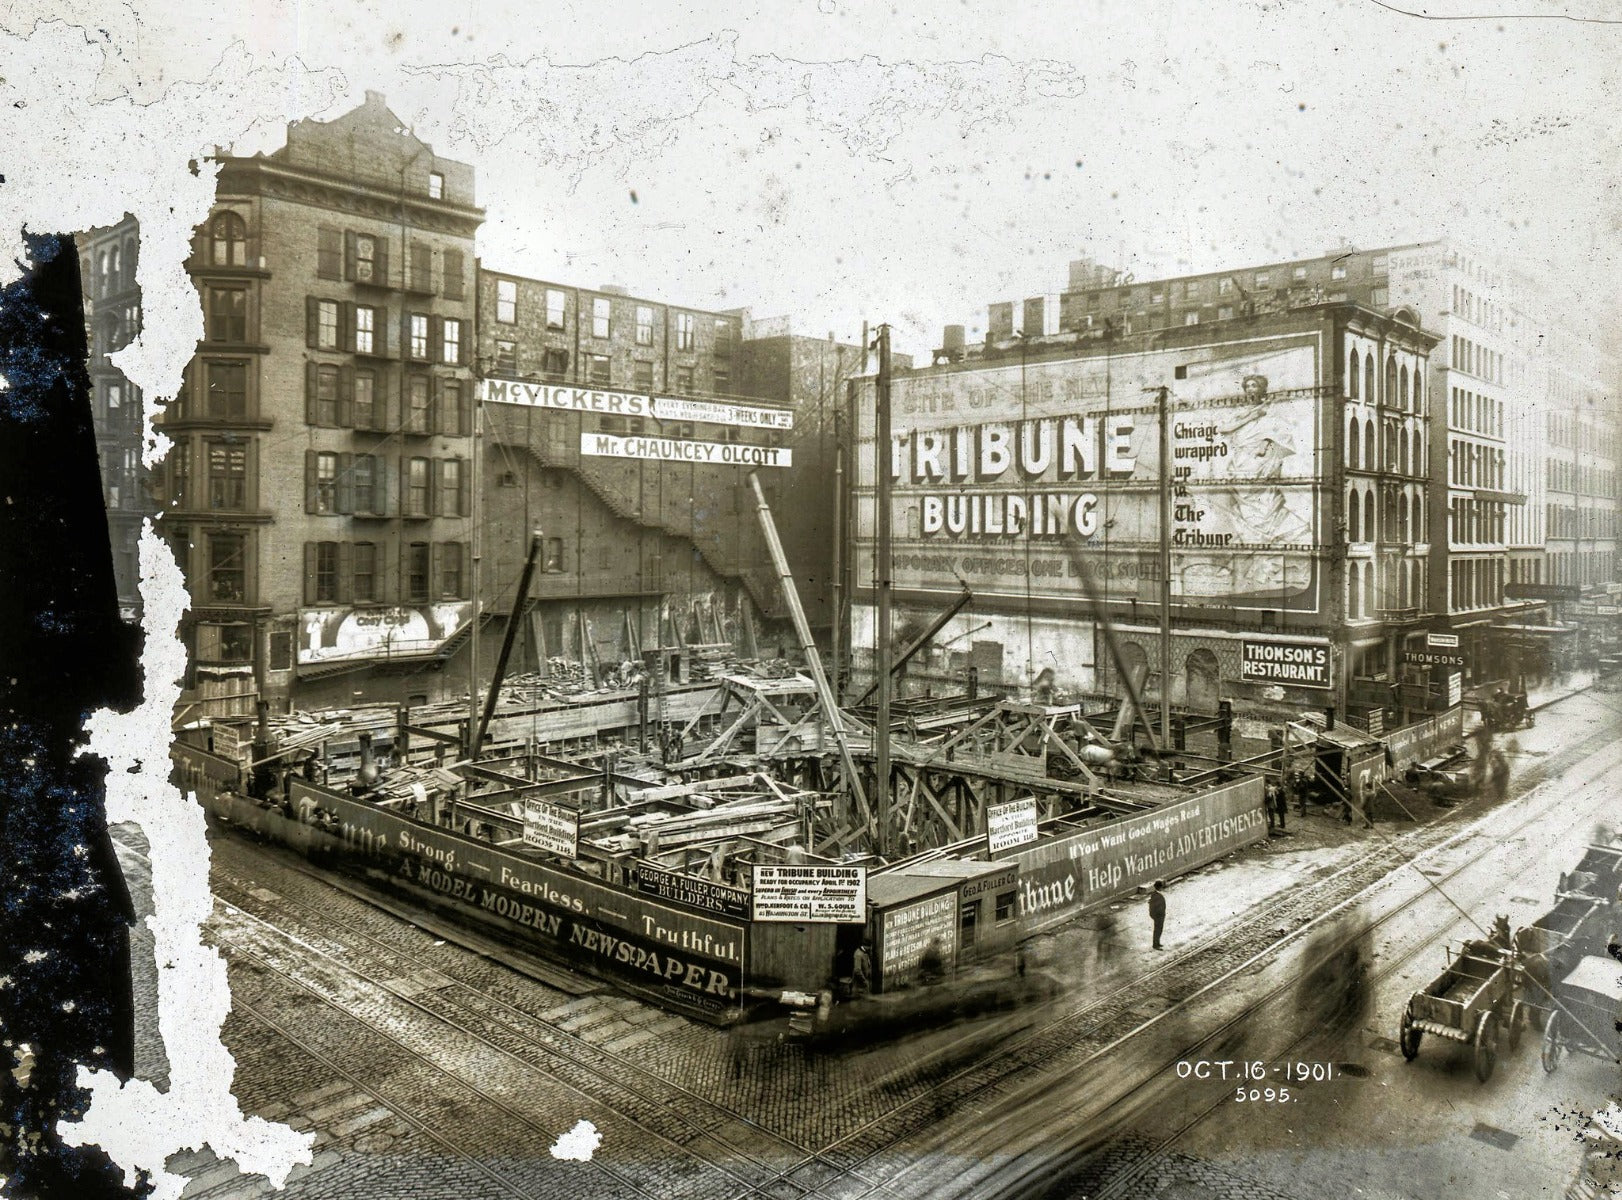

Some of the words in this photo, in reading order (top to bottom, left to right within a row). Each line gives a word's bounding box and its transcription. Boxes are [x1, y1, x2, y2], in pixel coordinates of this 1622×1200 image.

[624, 439, 715, 460] CHAUNCEY
[722, 445, 779, 465] OLCOTT
[890, 415, 1137, 483] TRIBUNE
[1174, 442, 1228, 462] wrapped
[1175, 466, 1191, 482] up
[922, 494, 1098, 539] BUILDING
[1174, 504, 1205, 522] The
[1173, 528, 1233, 546] Tribune
[1246, 644, 1326, 664] THOMSON'S
[1405, 652, 1464, 666] THOMSONS
[1244, 660, 1328, 682] RESTAURANT.
[1078, 841, 1100, 857] You
[1100, 833, 1126, 851] Want
[1128, 821, 1151, 840] Good
[1152, 814, 1180, 834] Wages
[1180, 805, 1200, 822] Read
[760, 869, 775, 877] NEW
[776, 868, 815, 878] TRIBUNE
[816, 868, 859, 878] BUILDING
[1088, 863, 1122, 892] Help
[1124, 842, 1174, 877] Wanted
[640, 869, 670, 885] GEORGE
[680, 879, 708, 896] FULLER
[1018, 873, 1075, 917] ibune
[418, 864, 476, 900] MODEL
[480, 888, 562, 937] MODERN
[894, 907, 920, 927] TRIBUNE
[920, 900, 950, 919] BUILDING
[641, 915, 740, 961] Truthful.
